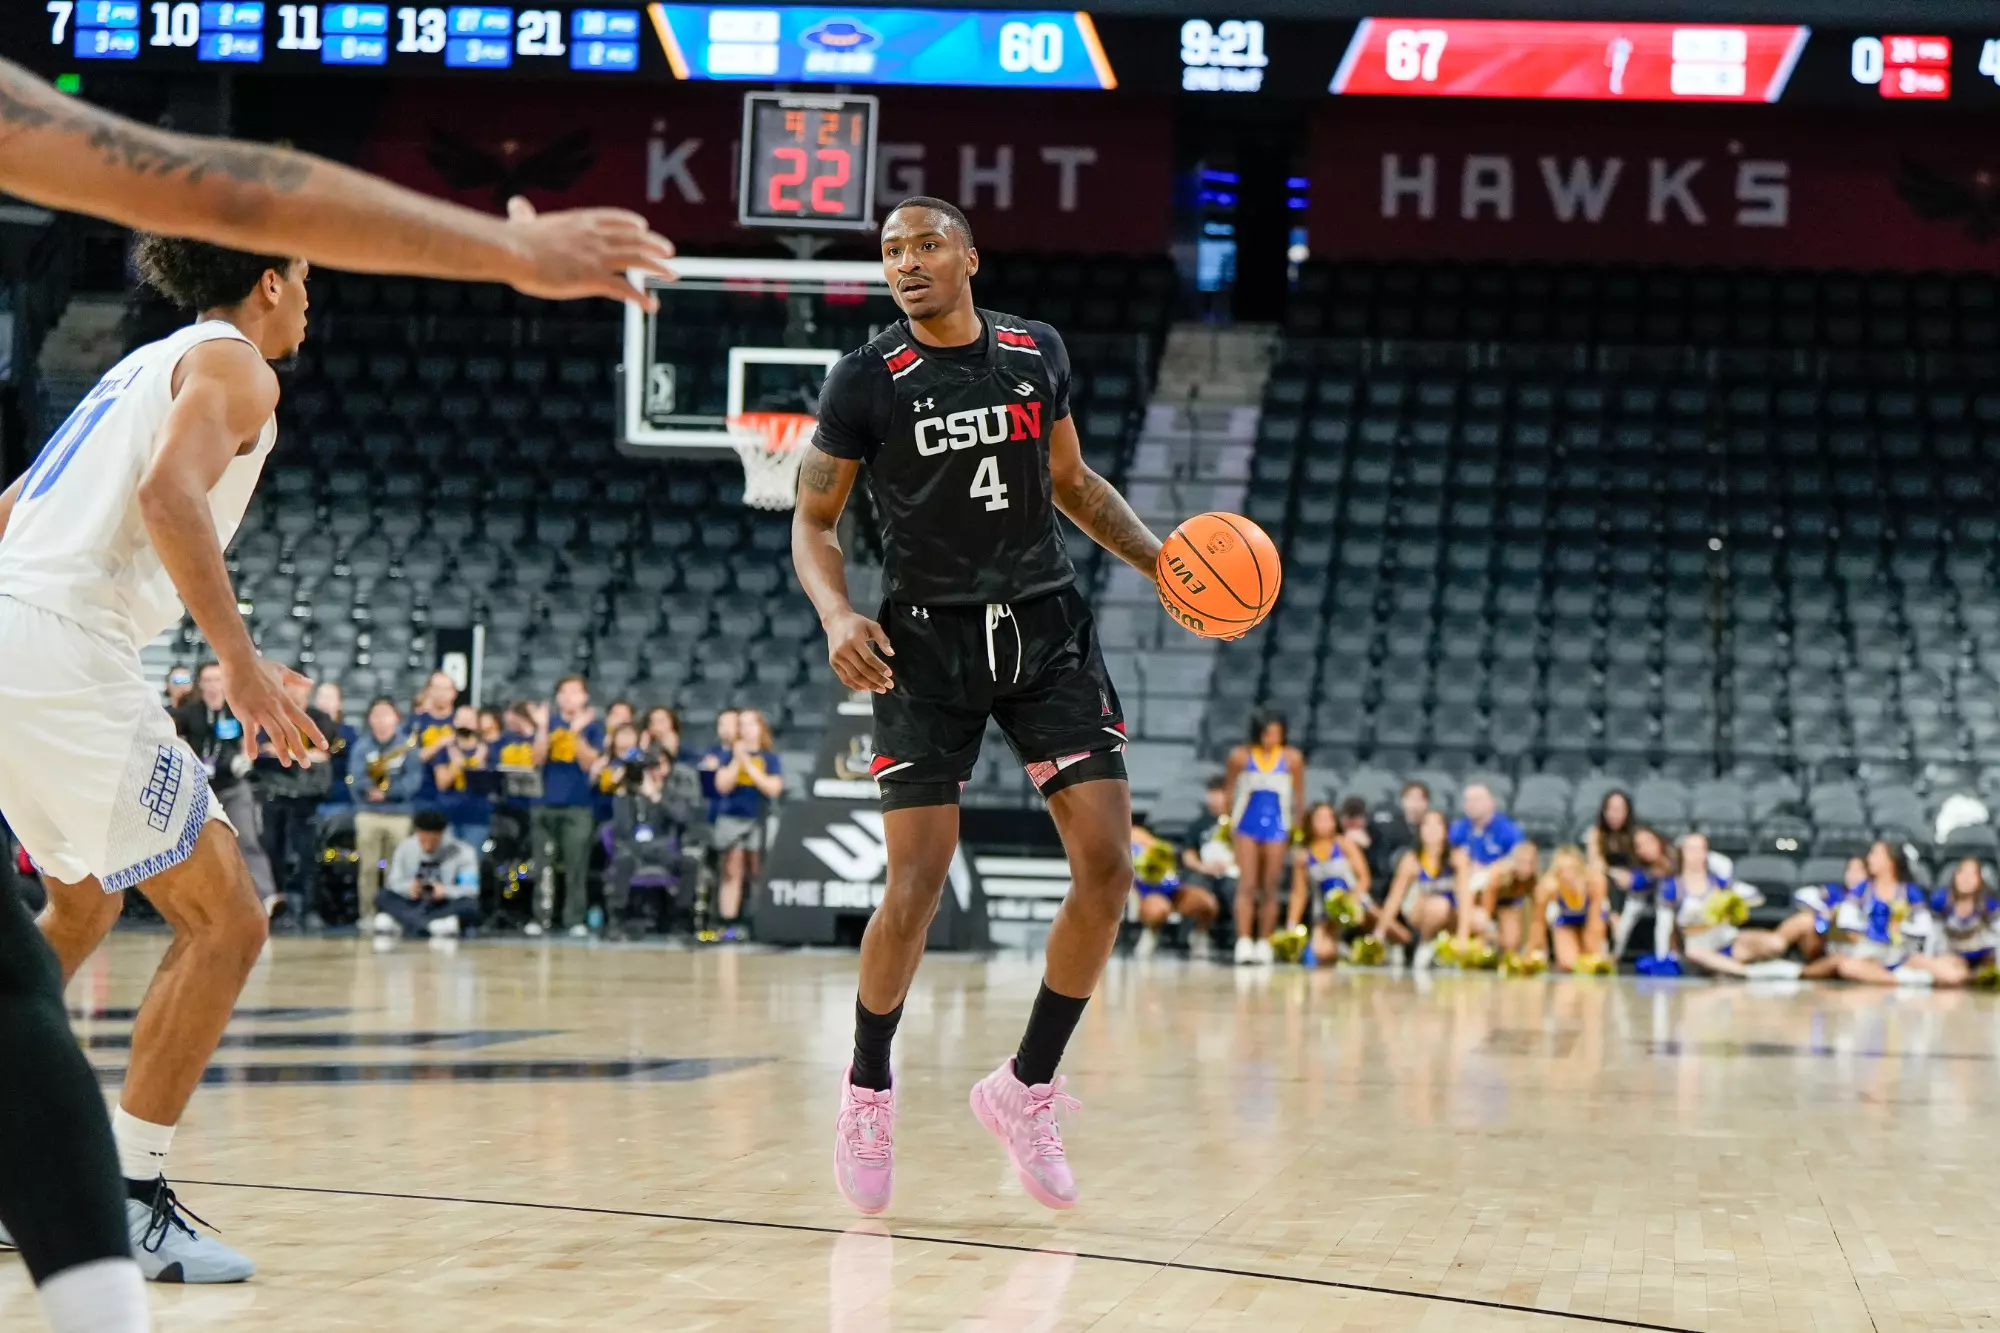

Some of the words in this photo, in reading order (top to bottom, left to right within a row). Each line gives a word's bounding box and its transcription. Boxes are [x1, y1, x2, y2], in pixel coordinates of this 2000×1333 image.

[46, 0, 74, 45] 7
[149, 2, 200, 47] 10
[277, 4, 323, 50] 11
[396, 7, 448, 53] 13
[516, 9, 566, 56] 21
[999, 21, 1064, 73] 60
[1180, 19, 1269, 68] 9:21
[1385, 29, 1448, 81] 67
[1851, 36, 1884, 85] 0
[647, 137, 1097, 211] KGHT
[768, 147, 850, 213] 22
[1380, 153, 1790, 228] HAWKS
[914, 401, 1042, 457] CSUN
[969, 455, 1010, 512] 4
[1168, 556, 1207, 595] EVO
[140, 744, 172, 811] SANTA
[767, 879, 820, 907] THE
